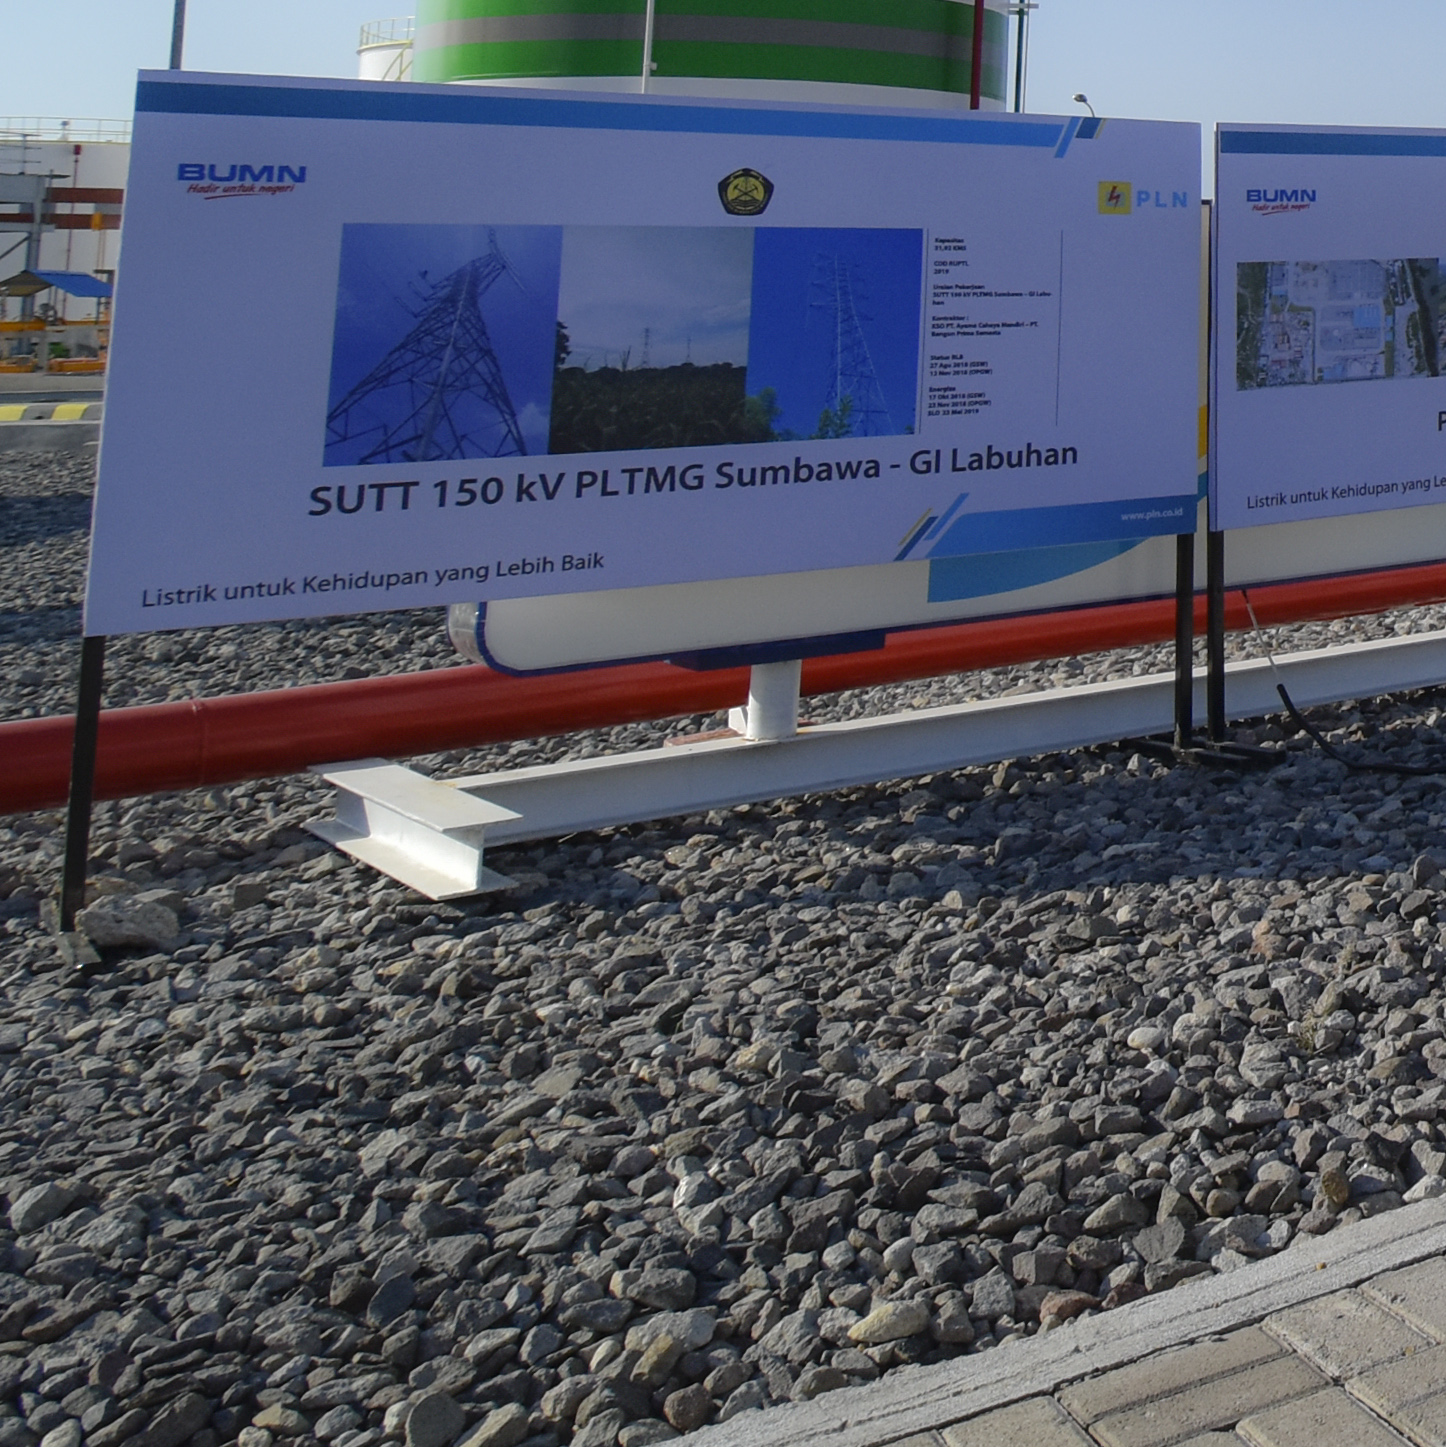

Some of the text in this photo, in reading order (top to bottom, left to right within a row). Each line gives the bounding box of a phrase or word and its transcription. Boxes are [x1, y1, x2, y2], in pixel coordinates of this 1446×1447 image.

[177, 163, 307, 183] BUMN
[187, 184, 295, 195] Hadir untuk negeri
[1137, 190, 1188, 207] PLN
[1246, 189, 1317, 202] BUMN
[308, 481, 420, 516] SUTT
[433, 477, 504, 508] 150
[515, 472, 566, 503] kV
[575, 463, 705, 498] PLTMG
[714, 456, 881, 488] Sumbawa
[909, 449, 941, 475] GI
[951, 442, 1079, 473] Labuhan
[1247, 492, 1287, 509] Listrik
[1290, 488, 1328, 504] untuk
[1331, 482, 1398, 500] Kehidupan
[1401, 478, 1431, 494] yang
[1121, 507, 1183, 521] www.pln.co.id
[141, 551, 605, 608] Listrik untuk Kehidupan yang Lebih Baik
